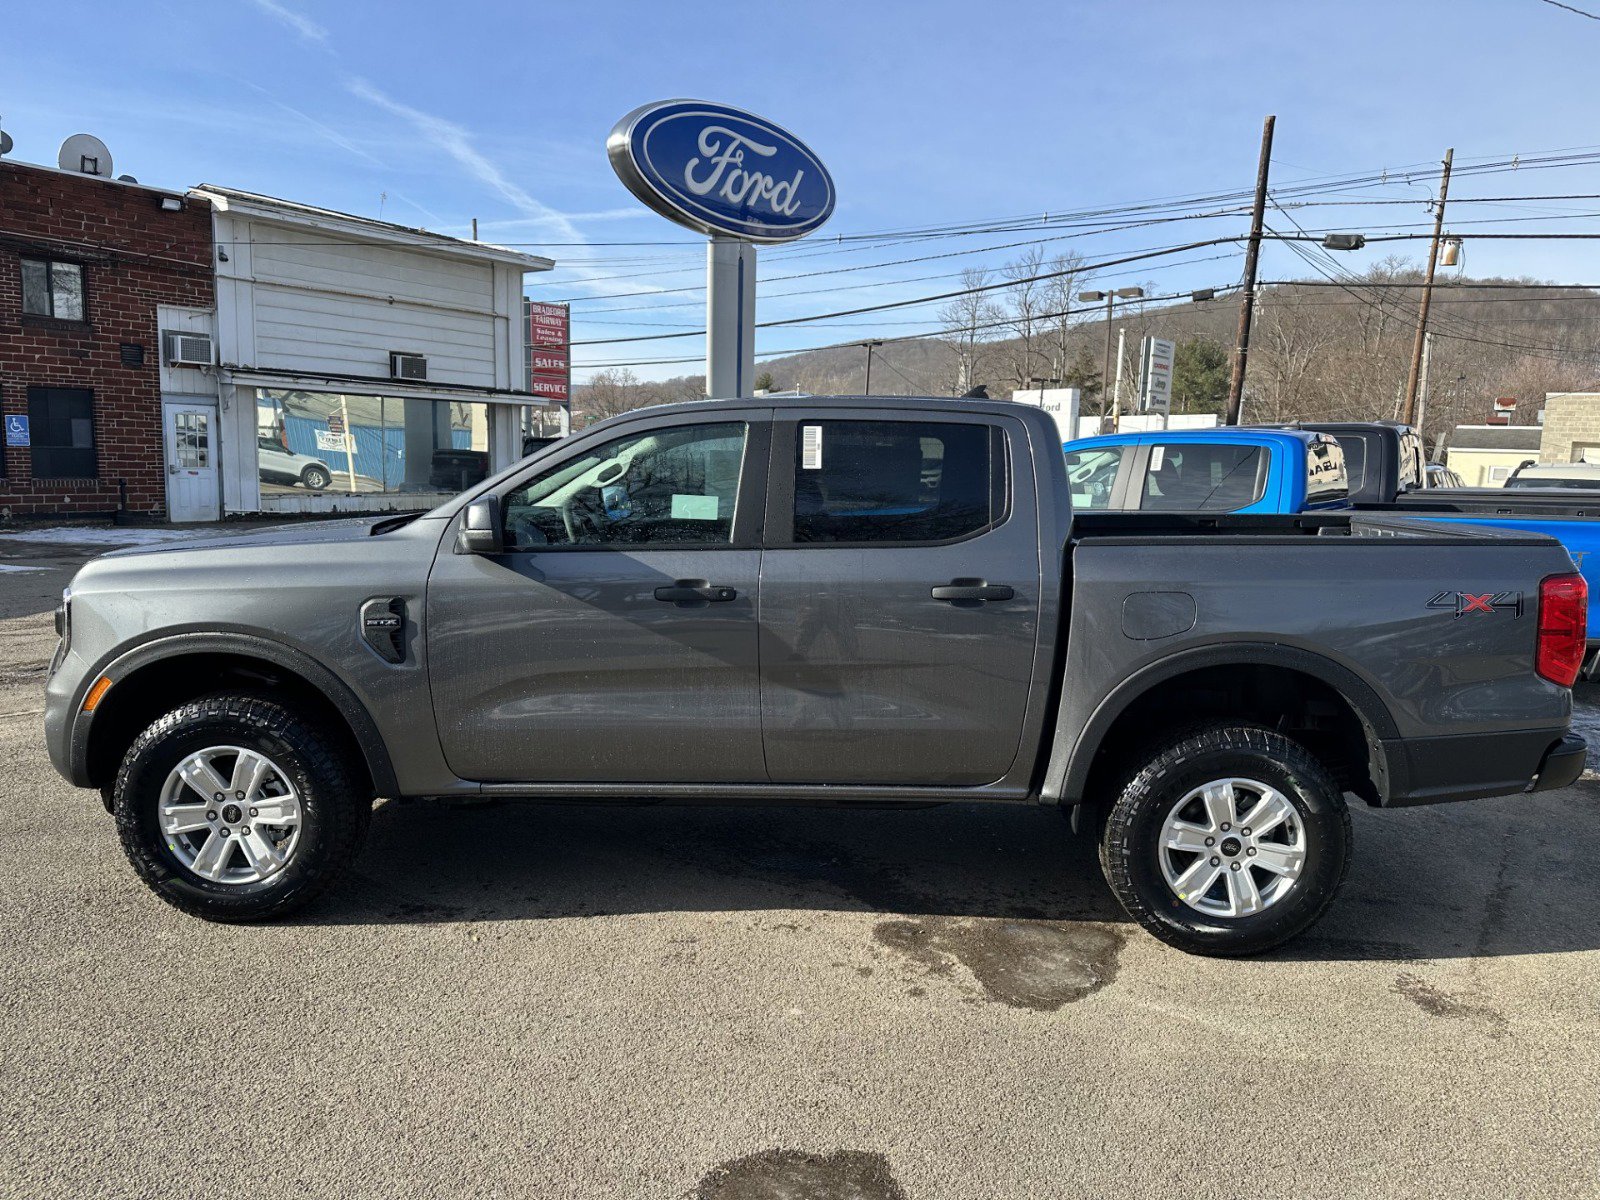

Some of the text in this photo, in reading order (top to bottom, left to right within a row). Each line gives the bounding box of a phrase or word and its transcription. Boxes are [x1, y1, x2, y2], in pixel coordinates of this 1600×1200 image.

[685, 126, 804, 216] Ford
[533, 304, 565, 317] BRADFORD
[536, 316, 562, 326] FAIRWAY
[535, 357, 565, 369] SALES
[534, 382, 567, 393] SERVICE
